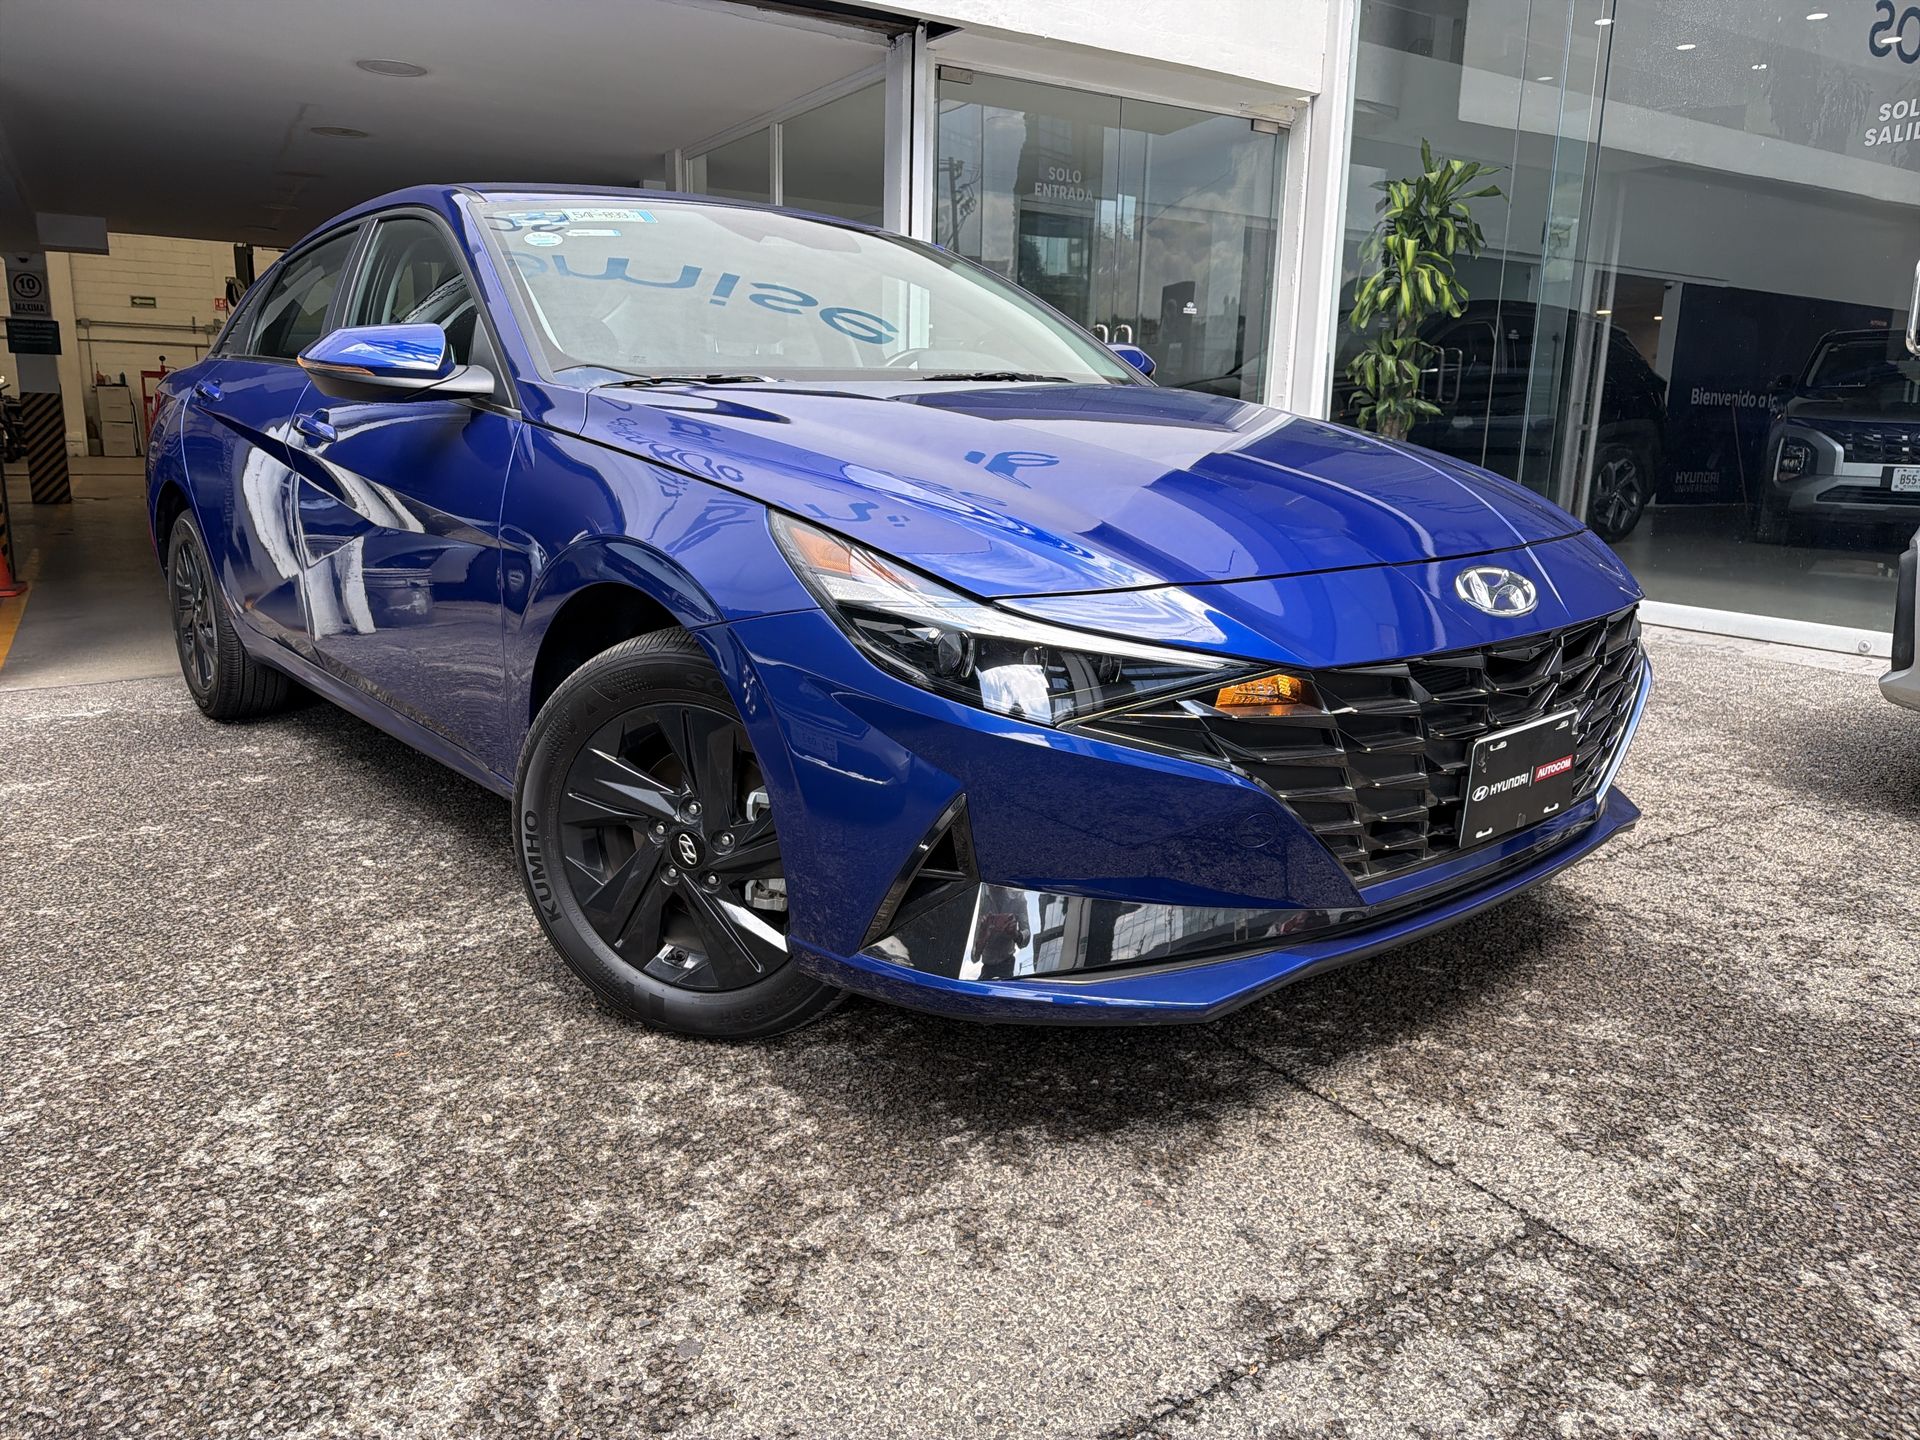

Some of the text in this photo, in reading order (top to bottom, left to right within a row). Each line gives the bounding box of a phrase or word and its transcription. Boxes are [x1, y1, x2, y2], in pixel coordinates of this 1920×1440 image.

[1048, 166, 1082, 184] SOLO
[1034, 182, 1095, 203] ENTRADA
[18, 277, 36, 290] 10
[1690, 387, 1757, 408] Bienvenido
[1758, 394, 1767, 408] a
[1675, 471, 1720, 484] HYUNDAI
[1490, 757, 1573, 796] HYUNDAI AUTOCOM
[524, 810, 563, 923] KUMHO
